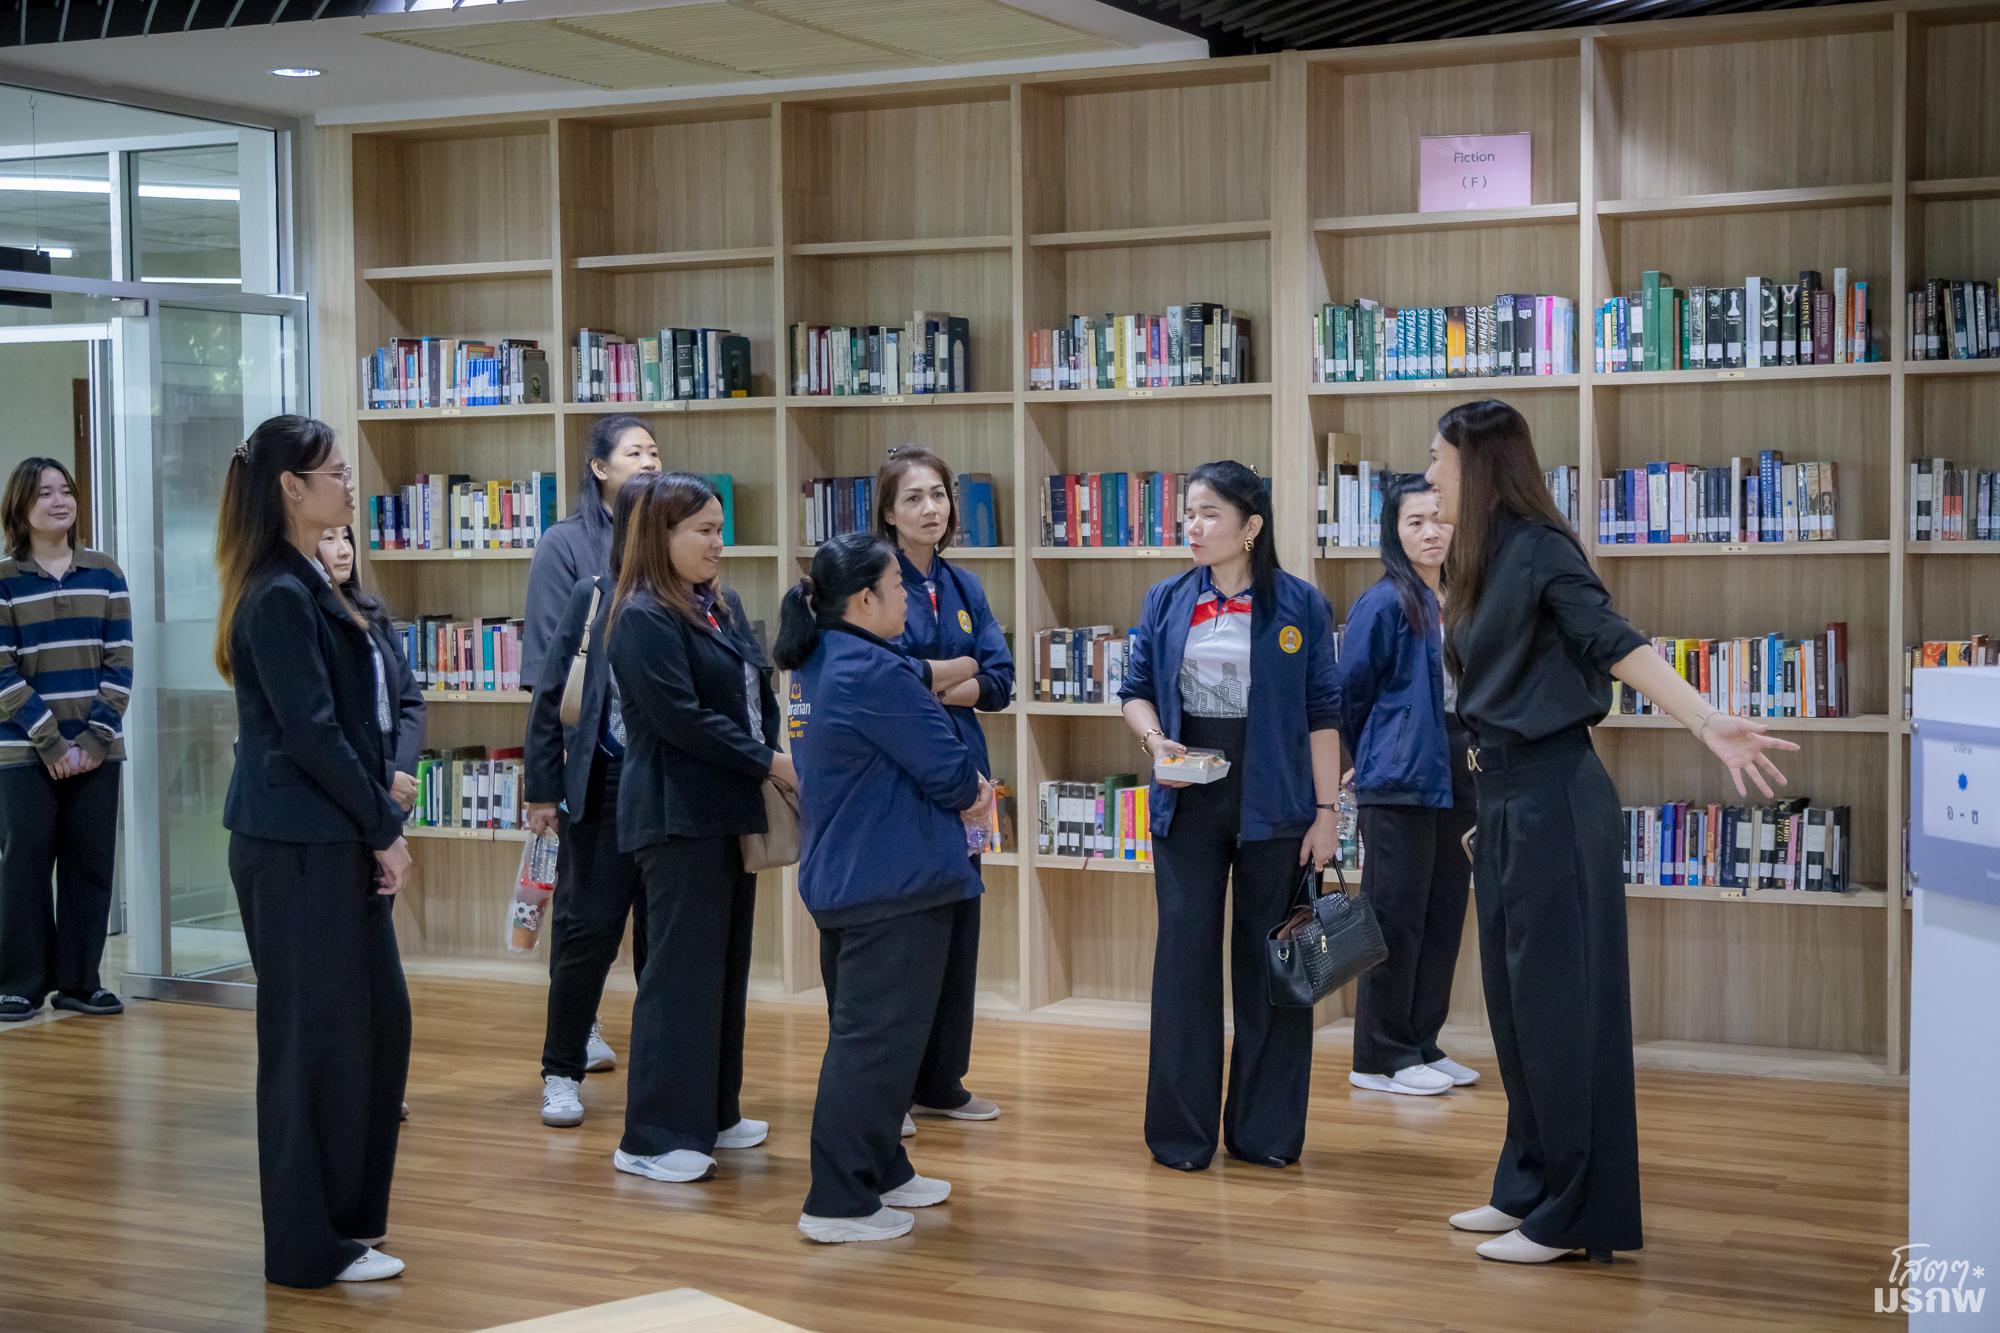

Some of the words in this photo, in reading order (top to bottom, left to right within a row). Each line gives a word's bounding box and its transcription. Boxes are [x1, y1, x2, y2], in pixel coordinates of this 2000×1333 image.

[1454, 151, 1495, 163] Fiction
[1405, 309, 1417, 352] STEPHEN
[1417, 307, 1430, 350] STEPHEN
[1431, 306, 1444, 350] STEPHEN
[1464, 305, 1477, 347] STEPHEN
[1477, 305, 1490, 347] STEPHEN
